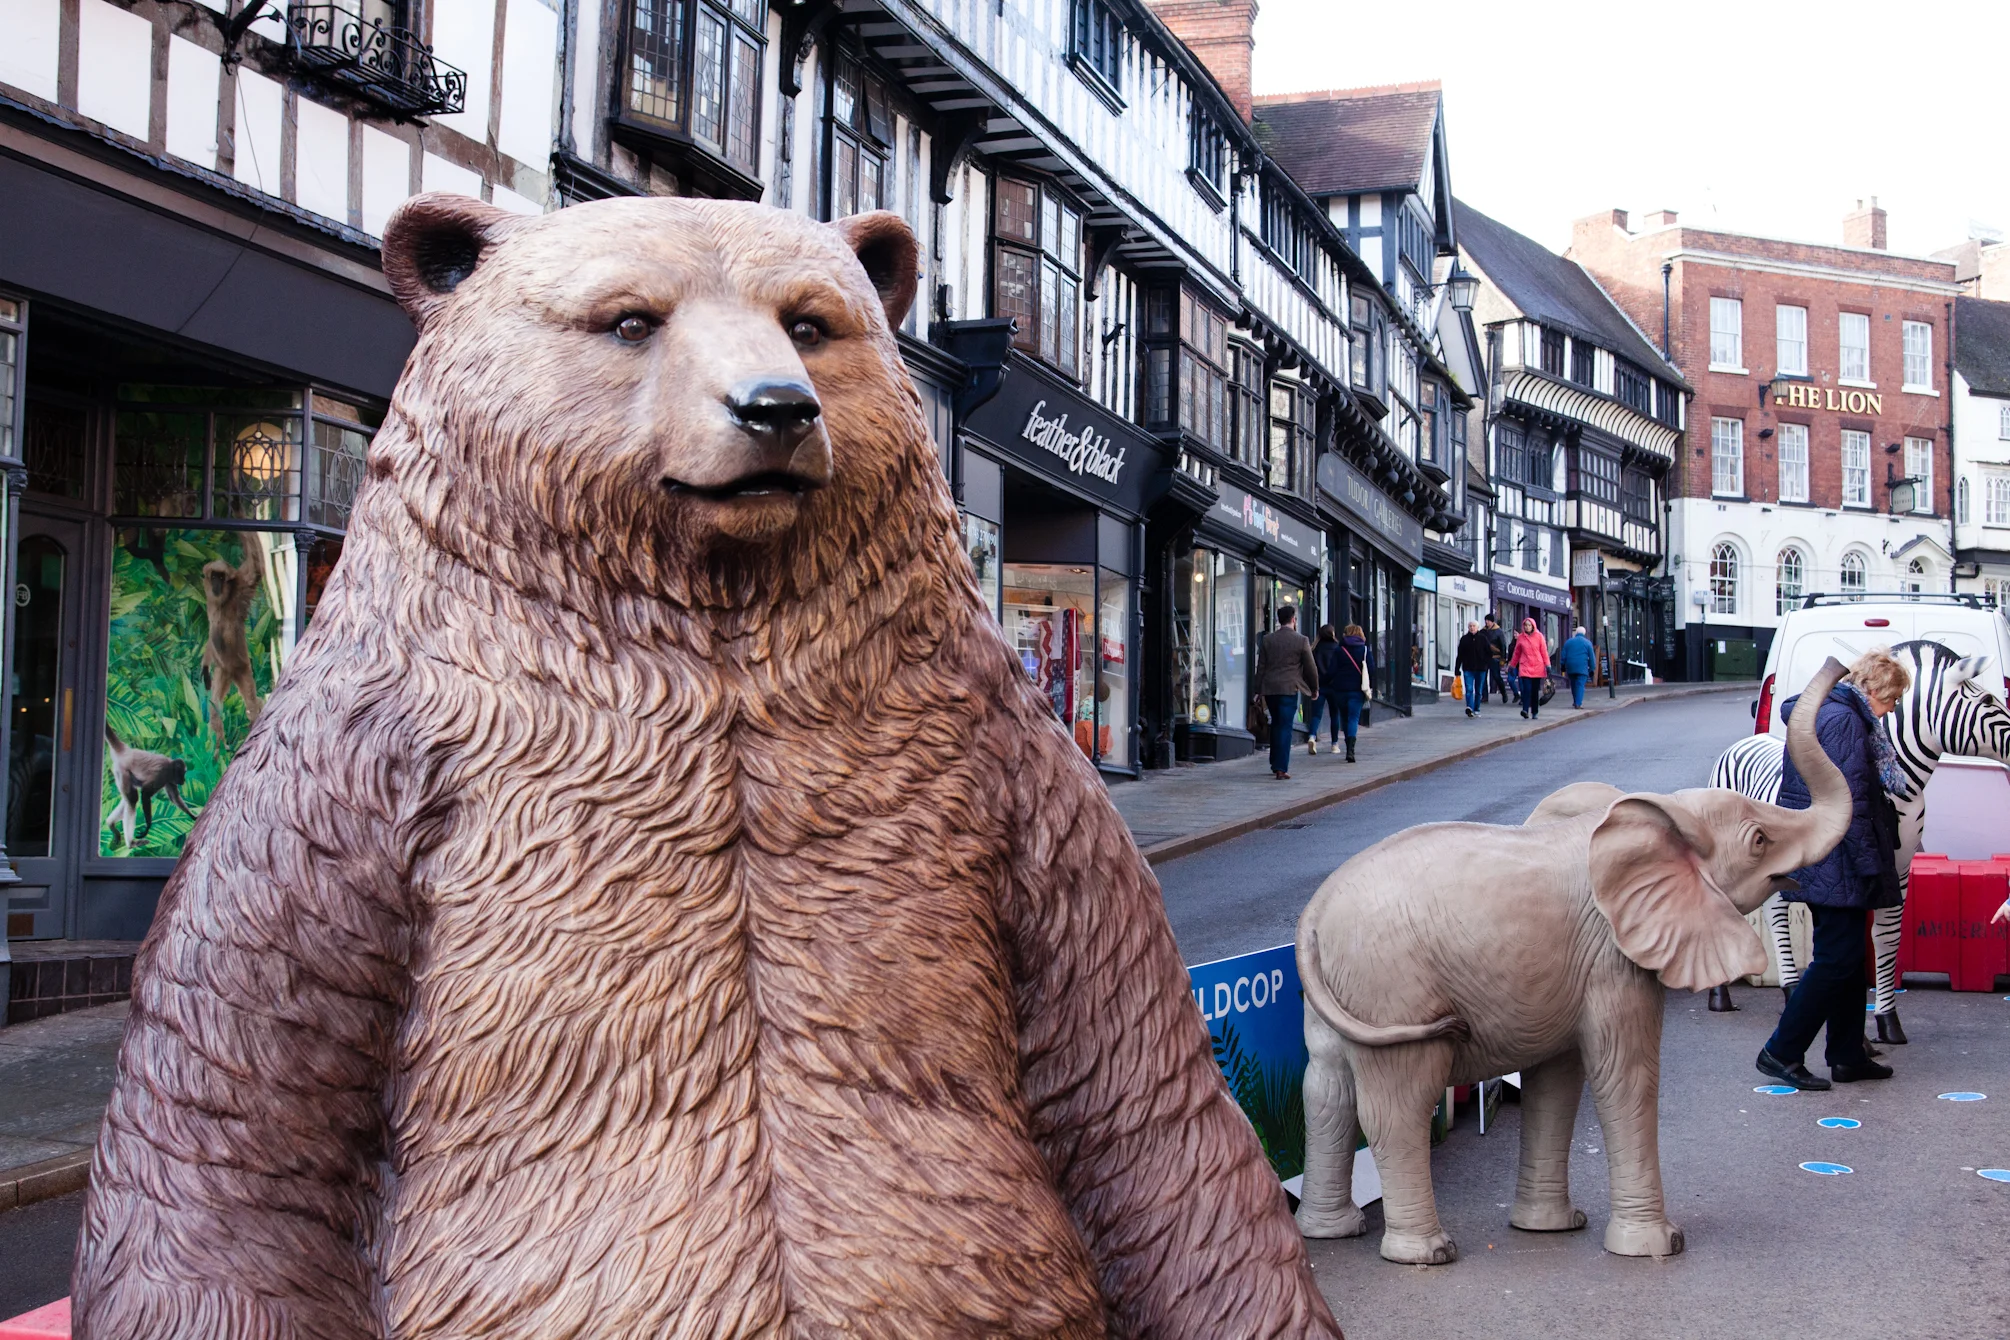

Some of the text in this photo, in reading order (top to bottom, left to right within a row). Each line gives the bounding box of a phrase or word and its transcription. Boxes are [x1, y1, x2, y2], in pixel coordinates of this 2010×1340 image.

[1825, 389, 1882, 415] LION
[1022, 400, 1125, 485] feather&black
[1347, 475, 1402, 537] TUDOR GALLERIES
